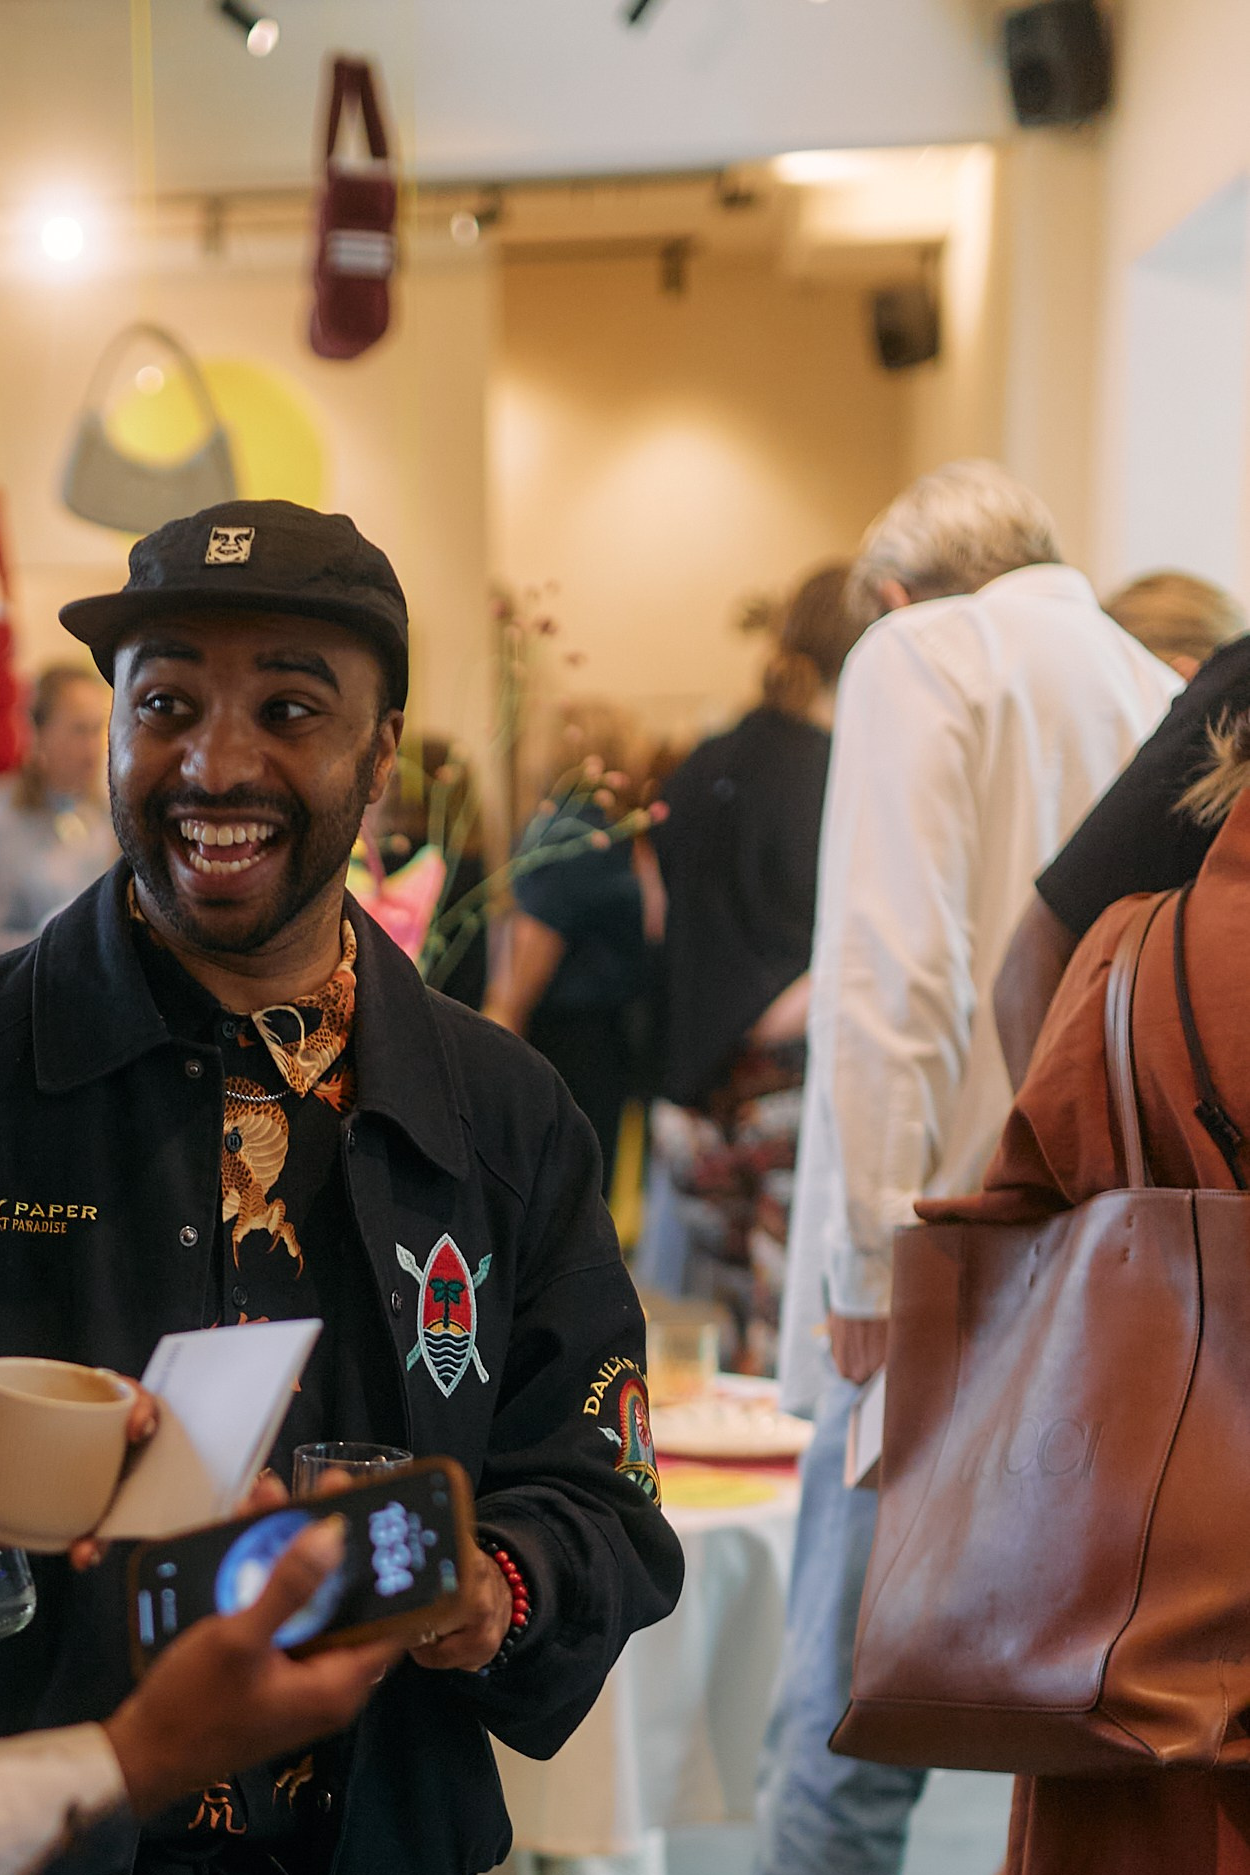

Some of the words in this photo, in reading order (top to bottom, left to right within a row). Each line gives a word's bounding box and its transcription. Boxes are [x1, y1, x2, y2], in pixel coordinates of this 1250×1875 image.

[14, 1201, 98, 1221] PAPER
[11, 1219, 68, 1235] PARADISE
[583, 1356, 626, 1416] DAILY
